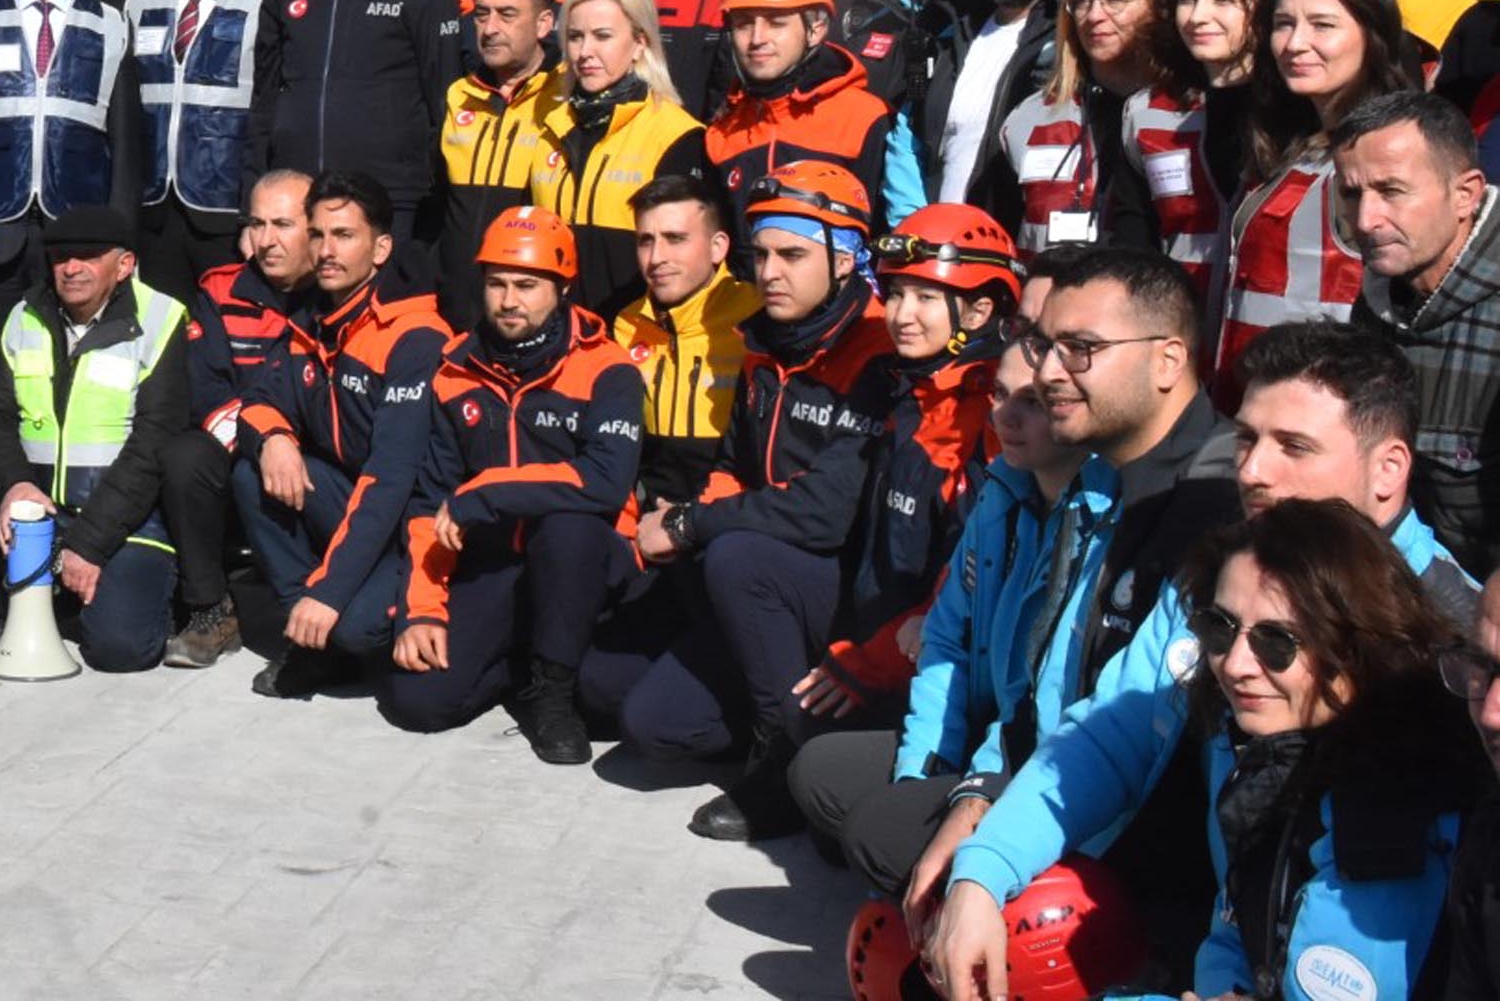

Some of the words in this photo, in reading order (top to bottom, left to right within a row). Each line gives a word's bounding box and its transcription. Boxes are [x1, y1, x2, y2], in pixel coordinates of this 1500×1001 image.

[366, 1, 403, 17] AFAD
[385, 384, 425, 403] AFAD
[791, 402, 833, 426] AFAD
